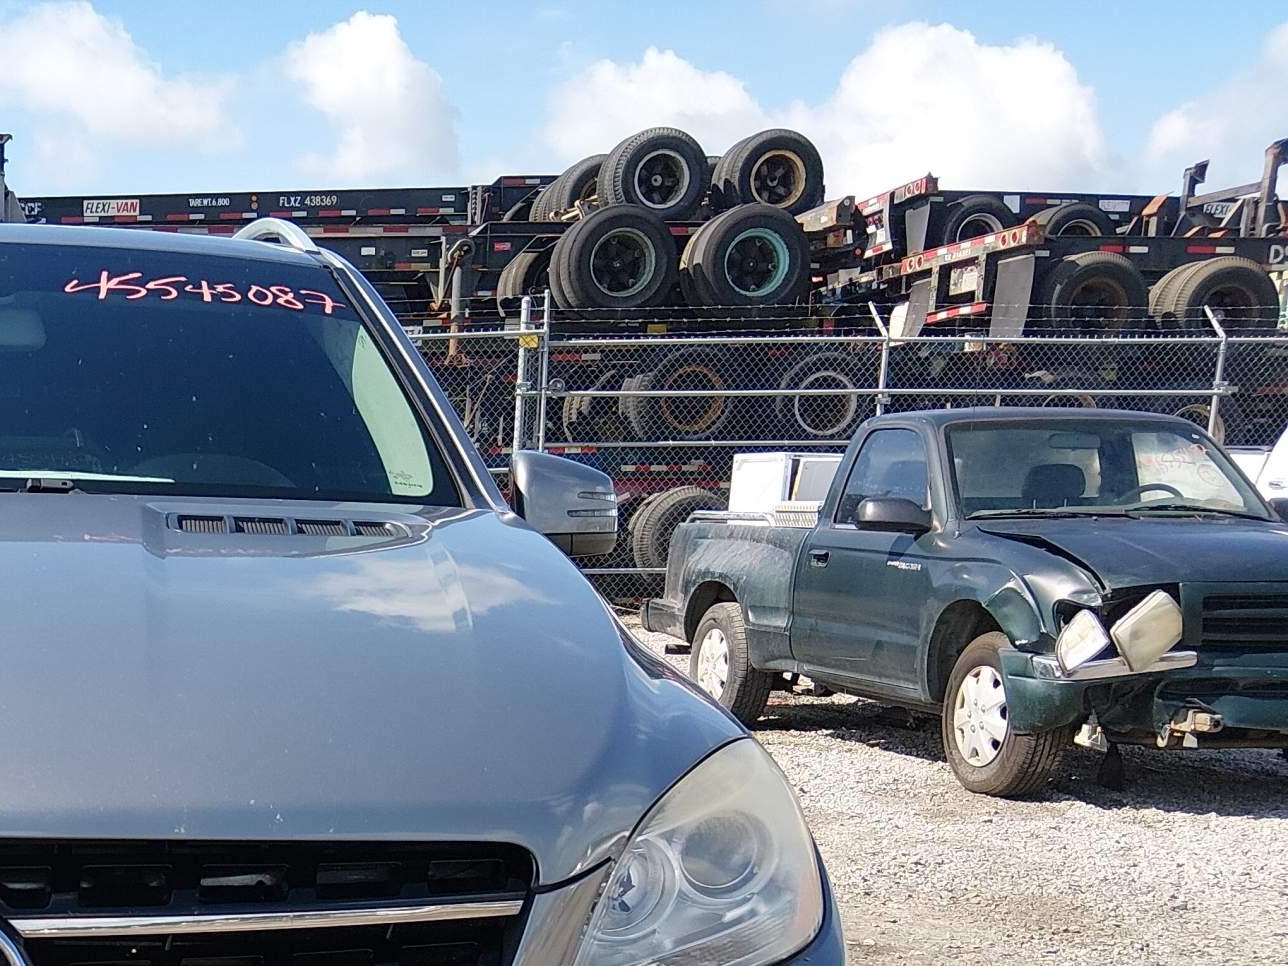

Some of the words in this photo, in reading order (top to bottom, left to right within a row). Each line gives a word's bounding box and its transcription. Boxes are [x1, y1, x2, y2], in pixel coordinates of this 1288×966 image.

[85, 200, 138, 214] FLEXI-VAN
[279, 196, 301, 207] FLXZ
[304, 195, 337, 207] 438369
[64, 270, 346, 314] 45545087
